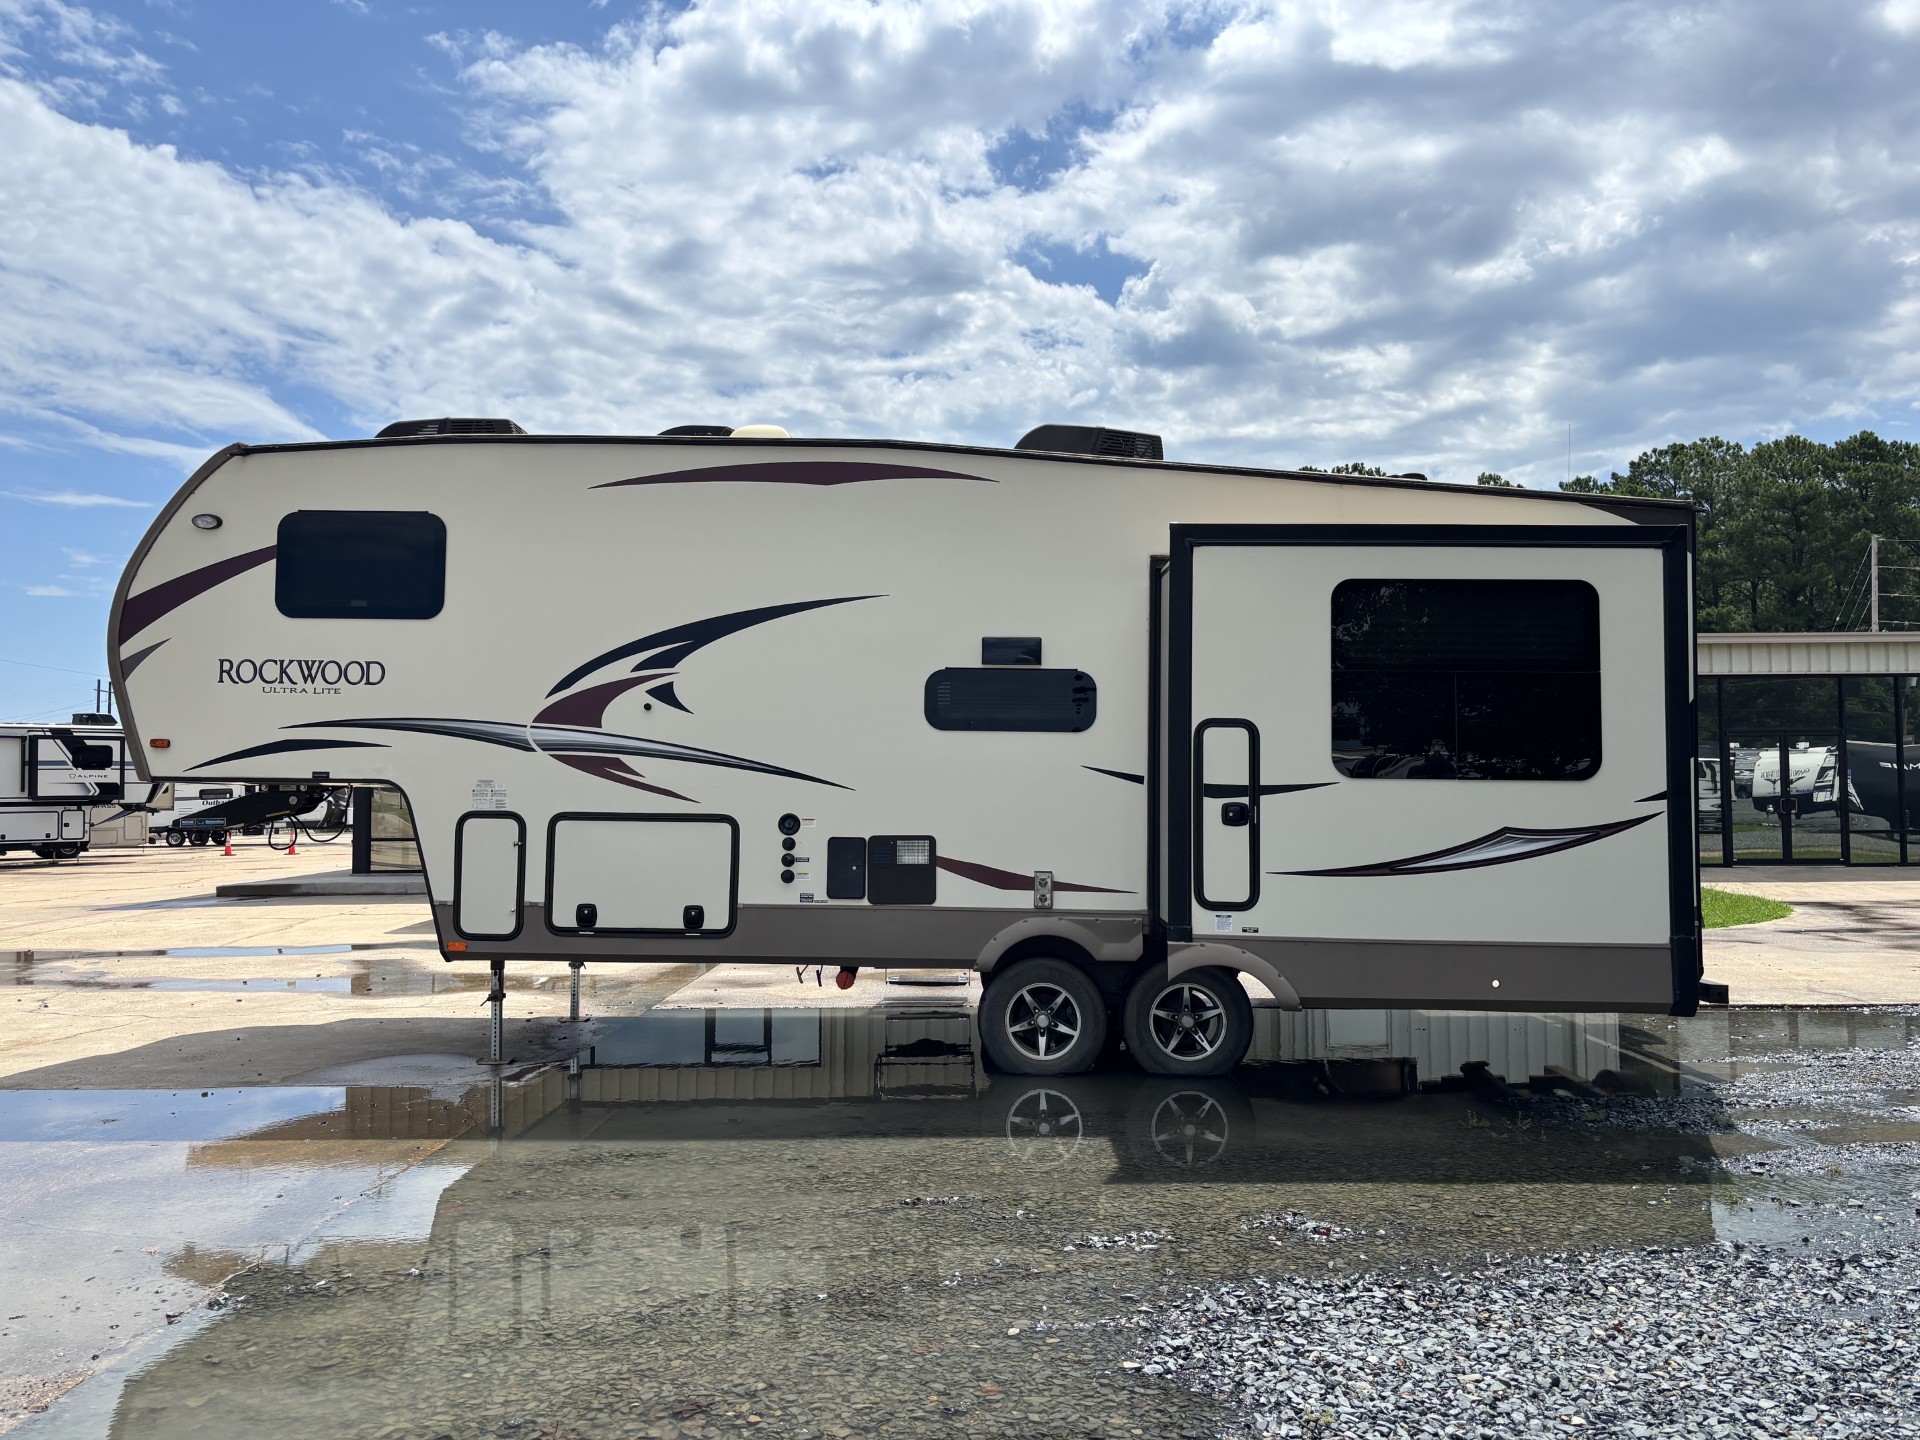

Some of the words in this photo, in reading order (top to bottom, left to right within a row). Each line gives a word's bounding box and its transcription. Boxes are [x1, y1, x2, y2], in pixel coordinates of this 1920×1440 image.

[217, 658, 386, 686] ROCKWOOD
[262, 686, 309, 694] ULTRA
[312, 687, 342, 695] LITE
